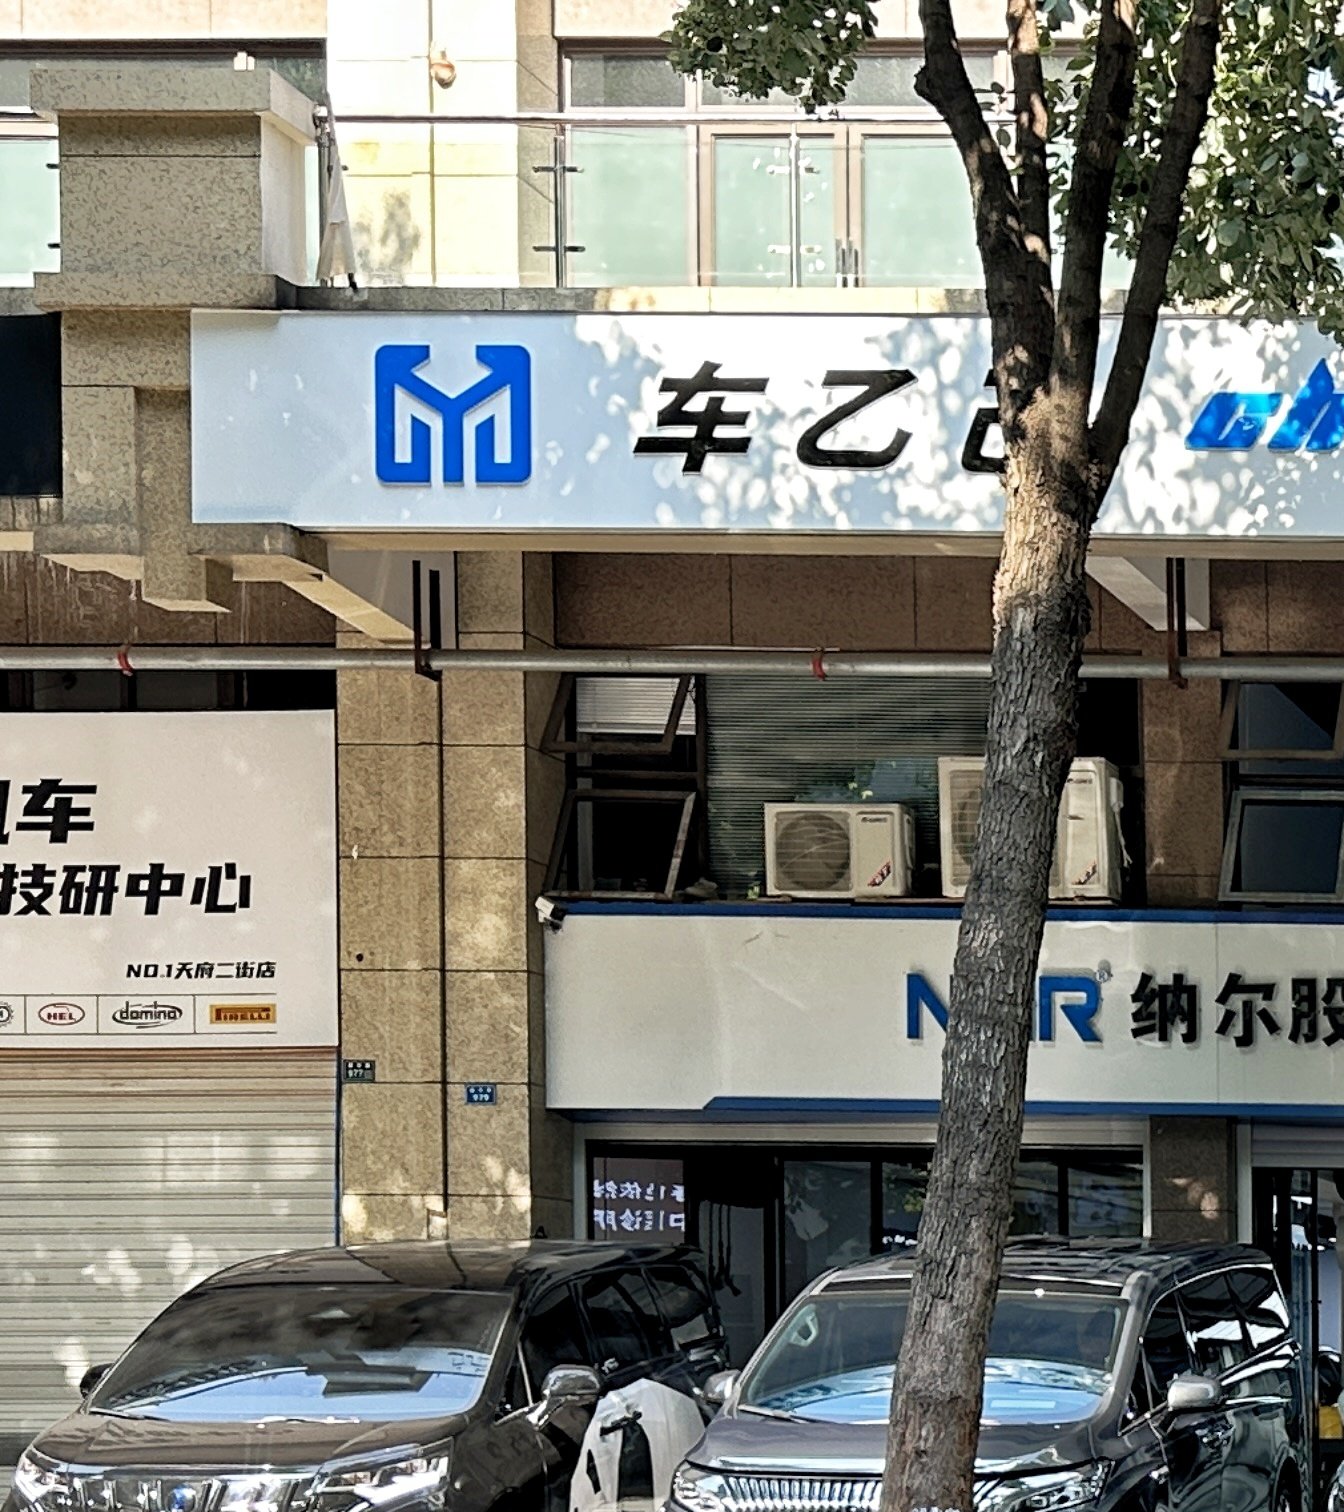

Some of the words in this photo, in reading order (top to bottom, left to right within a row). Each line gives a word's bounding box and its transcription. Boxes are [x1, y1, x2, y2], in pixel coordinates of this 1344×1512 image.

[0, 778, 98, 846] 车
[0, 862, 252, 916] 技研中心
[907, 973, 1102, 1042] NR
